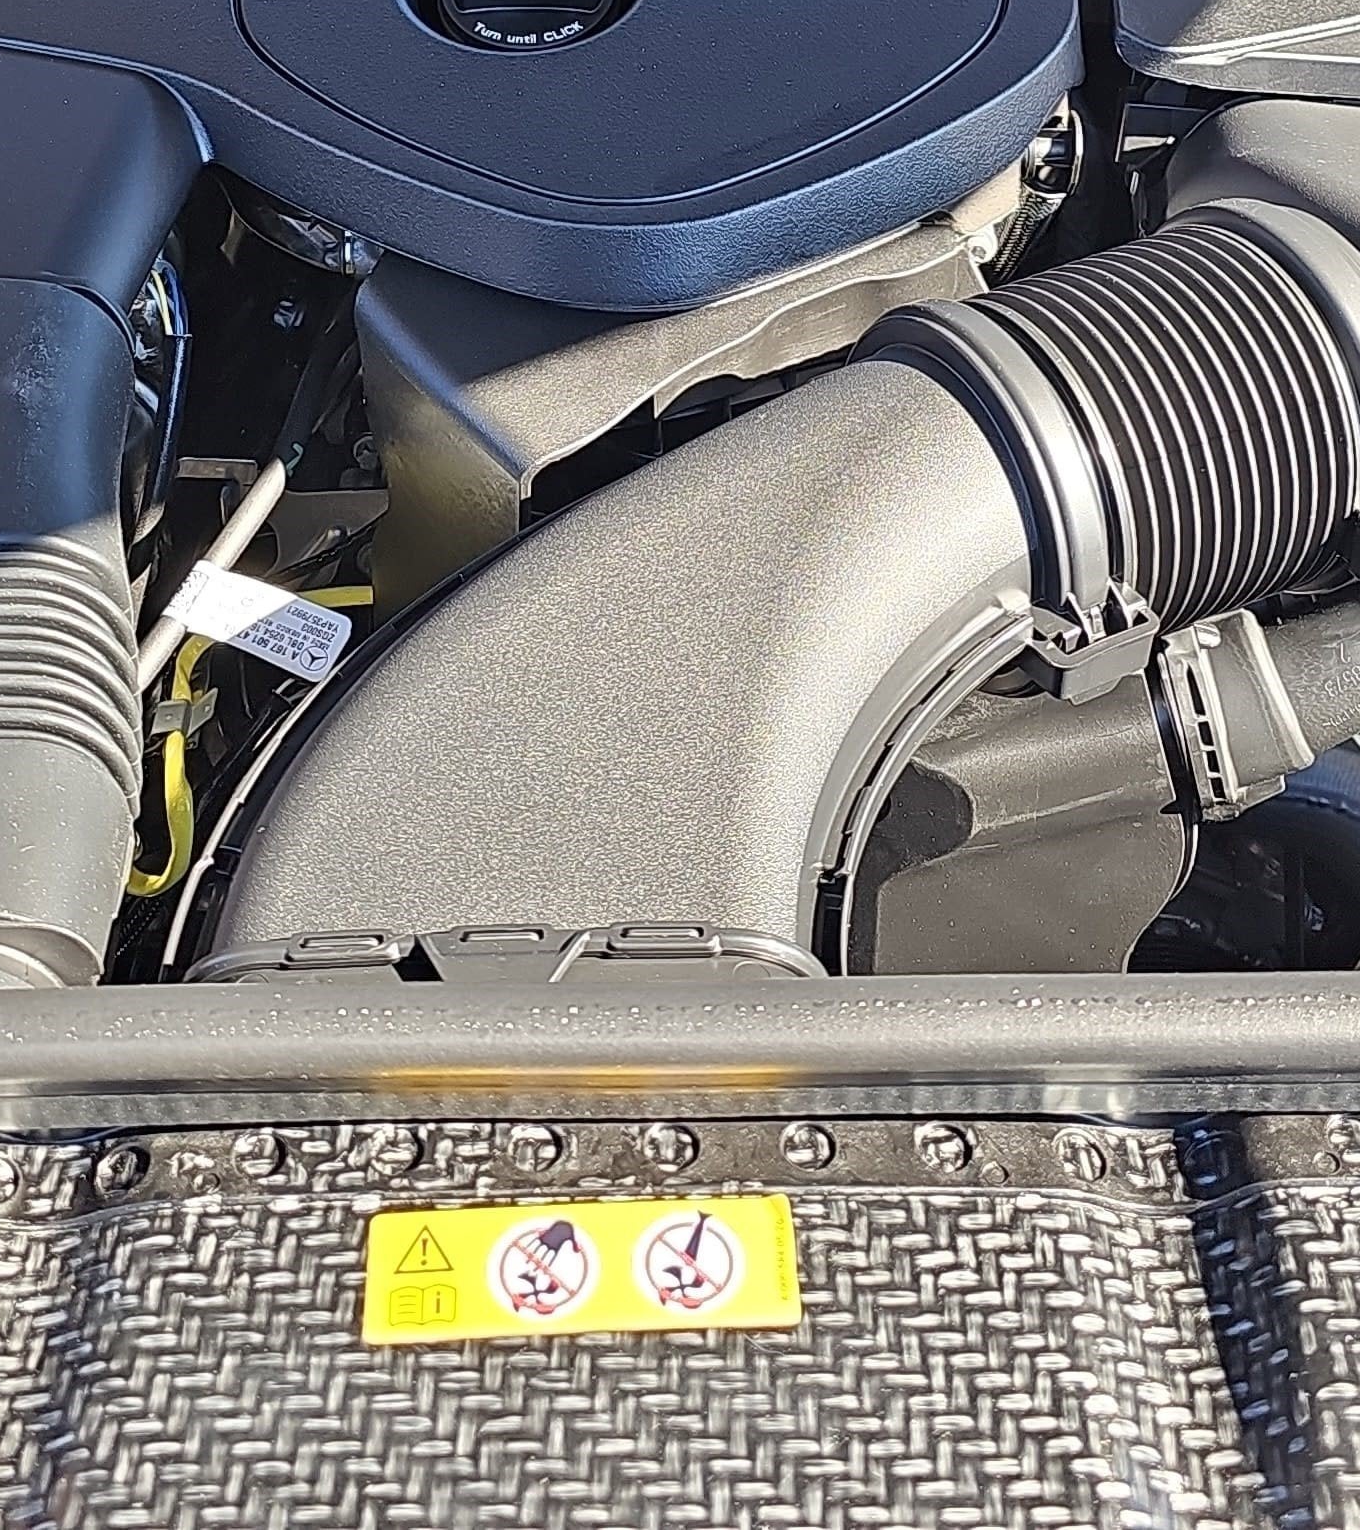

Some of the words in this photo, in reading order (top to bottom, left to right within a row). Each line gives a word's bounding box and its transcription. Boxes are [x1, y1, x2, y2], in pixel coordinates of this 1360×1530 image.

[472, 21, 502, 41] Turn
[506, 33, 537, 44] until
[543, 20, 584, 42] CLICK
[286, 605, 341, 633] YAP3579921
[275, 623, 301, 638] MEXICO
[251, 634, 270, 648] 501
[270, 642, 288, 656] 167
[290, 650, 300, 660] A
